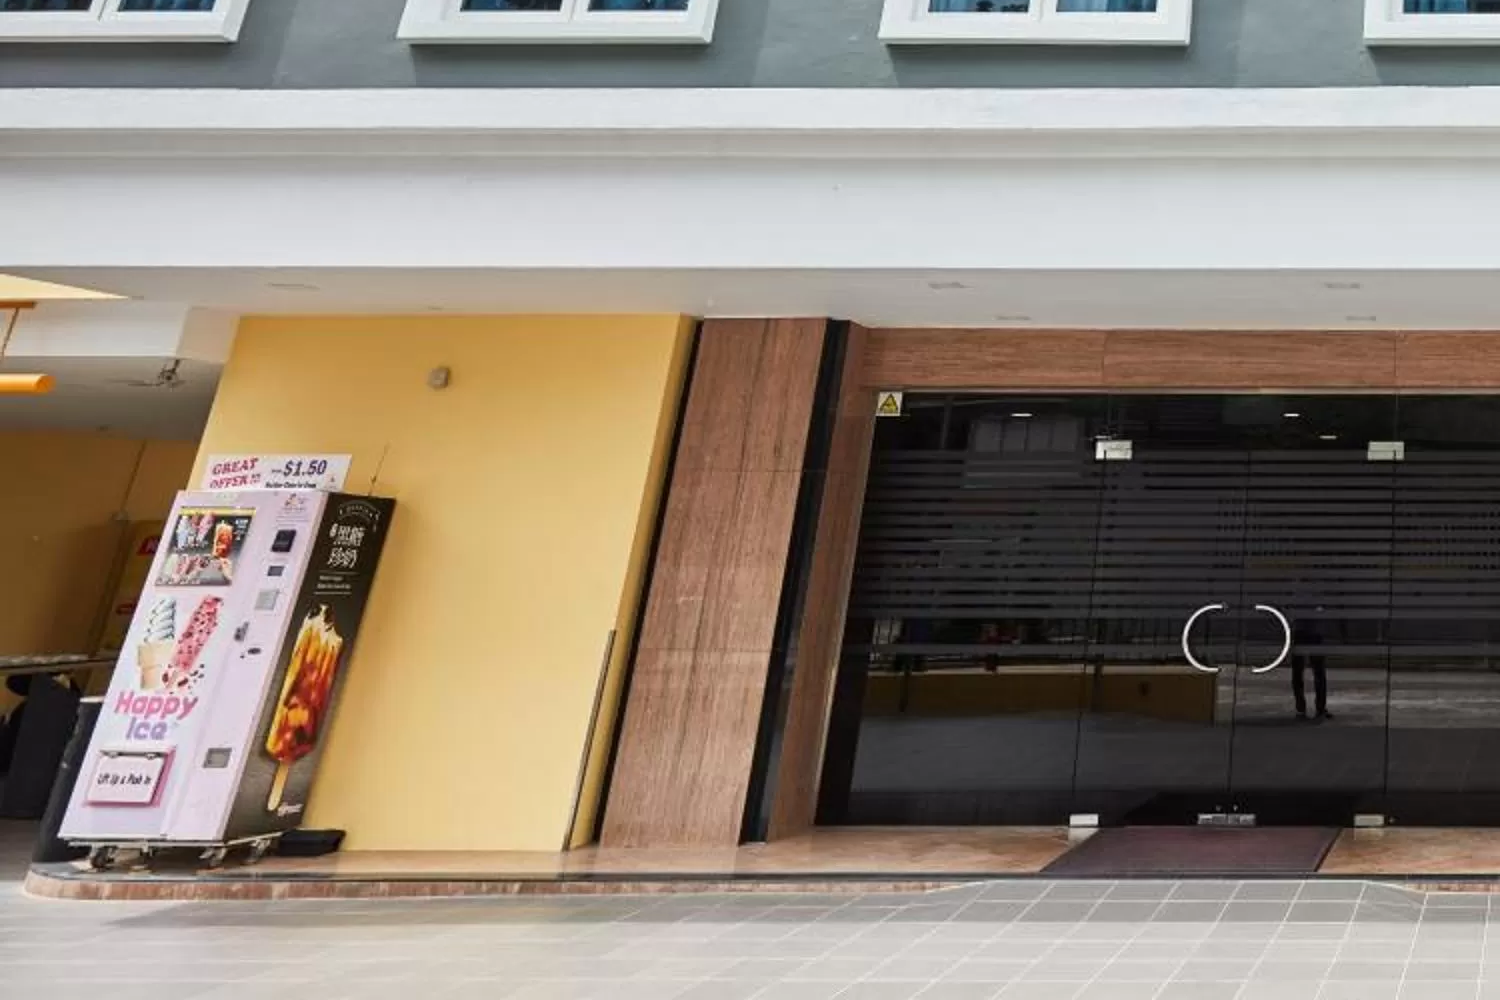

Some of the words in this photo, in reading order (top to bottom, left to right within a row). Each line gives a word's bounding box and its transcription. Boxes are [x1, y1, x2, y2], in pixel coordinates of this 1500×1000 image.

[212, 457, 259, 475] GREAT
[283, 459, 328, 477] $1.50
[114, 690, 199, 720] Happy
[126, 717, 168, 740] Ice
